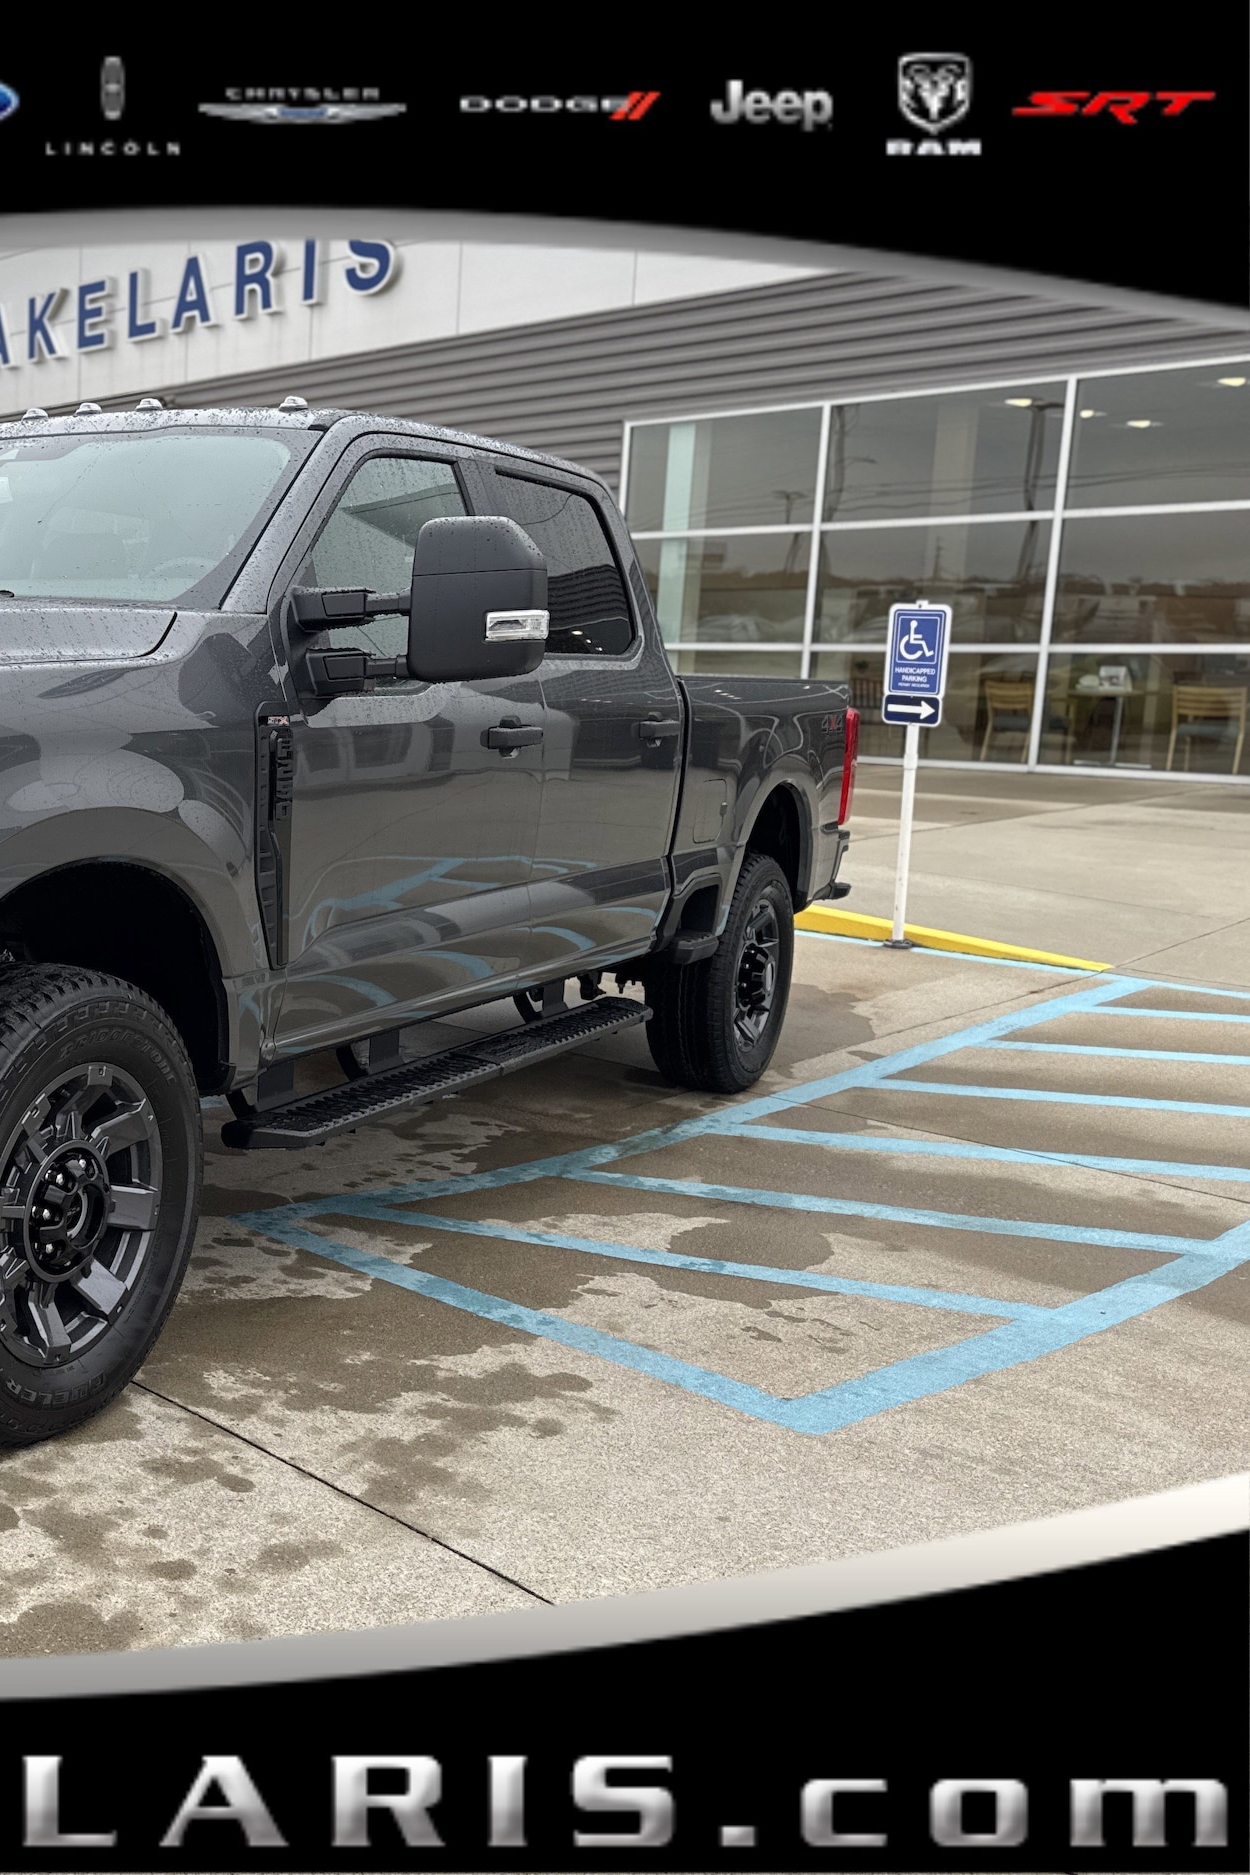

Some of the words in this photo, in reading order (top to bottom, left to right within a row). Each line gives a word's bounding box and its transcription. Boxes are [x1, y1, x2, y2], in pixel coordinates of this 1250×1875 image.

[894, 667, 936, 675] HANDICAPPED
[58, 1025, 178, 1087] BRIDGESTONE
[6, 1369, 106, 1406] DUELER
